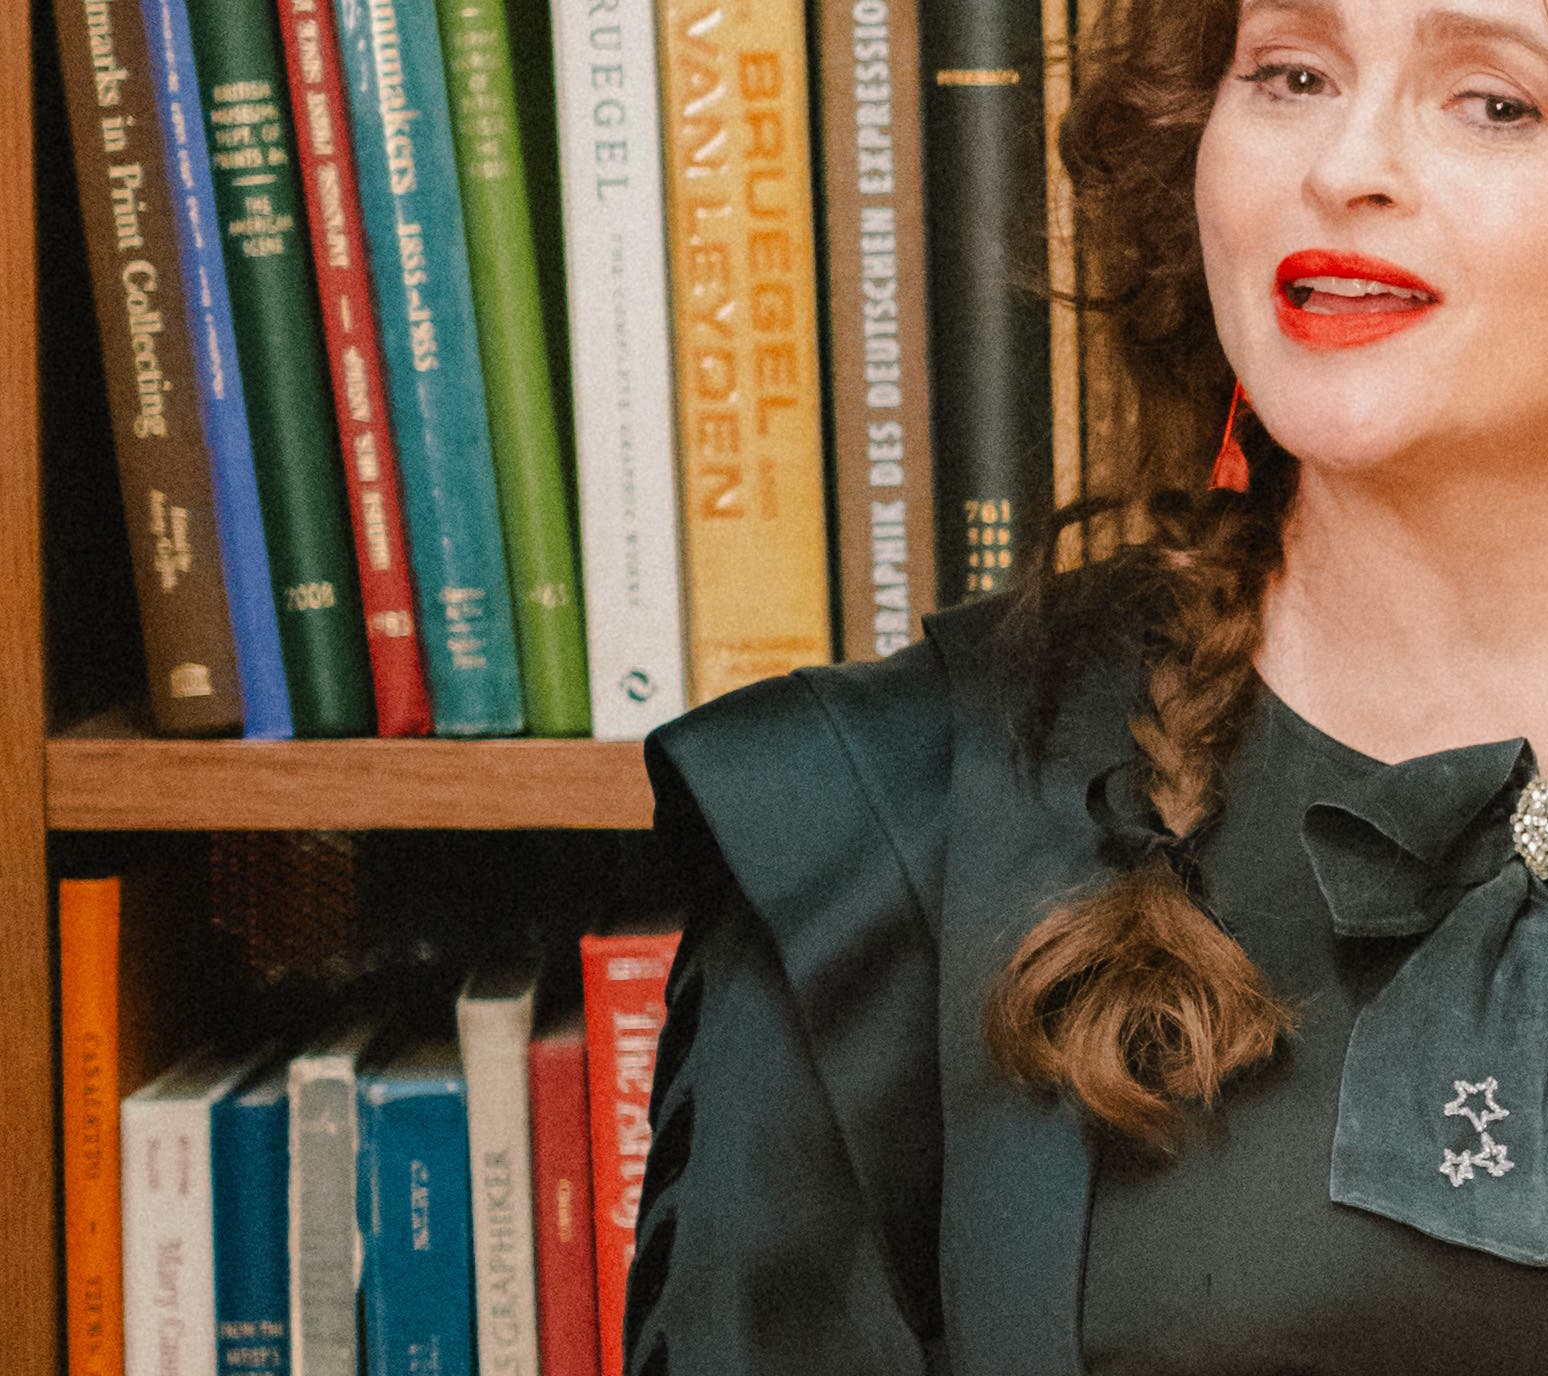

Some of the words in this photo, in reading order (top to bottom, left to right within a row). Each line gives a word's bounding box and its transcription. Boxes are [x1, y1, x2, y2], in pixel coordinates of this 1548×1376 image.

[101, 115, 135, 153] in
[670, 6, 731, 180] VAN
[109, 163, 147, 252] Print
[737, 49, 803, 437] BRUEGEL
[123, 259, 173, 439] Collecting
[685, 196, 746, 523] LEYDEN
[855, 207, 901, 409] DEUTSCHEN
[866, 422, 905, 487] DES
[871, 501, 910, 660] GRAPHIK
[155, 1241, 183, 1306] Mary
[482, 1149, 522, 1346] GRAPHIKER
